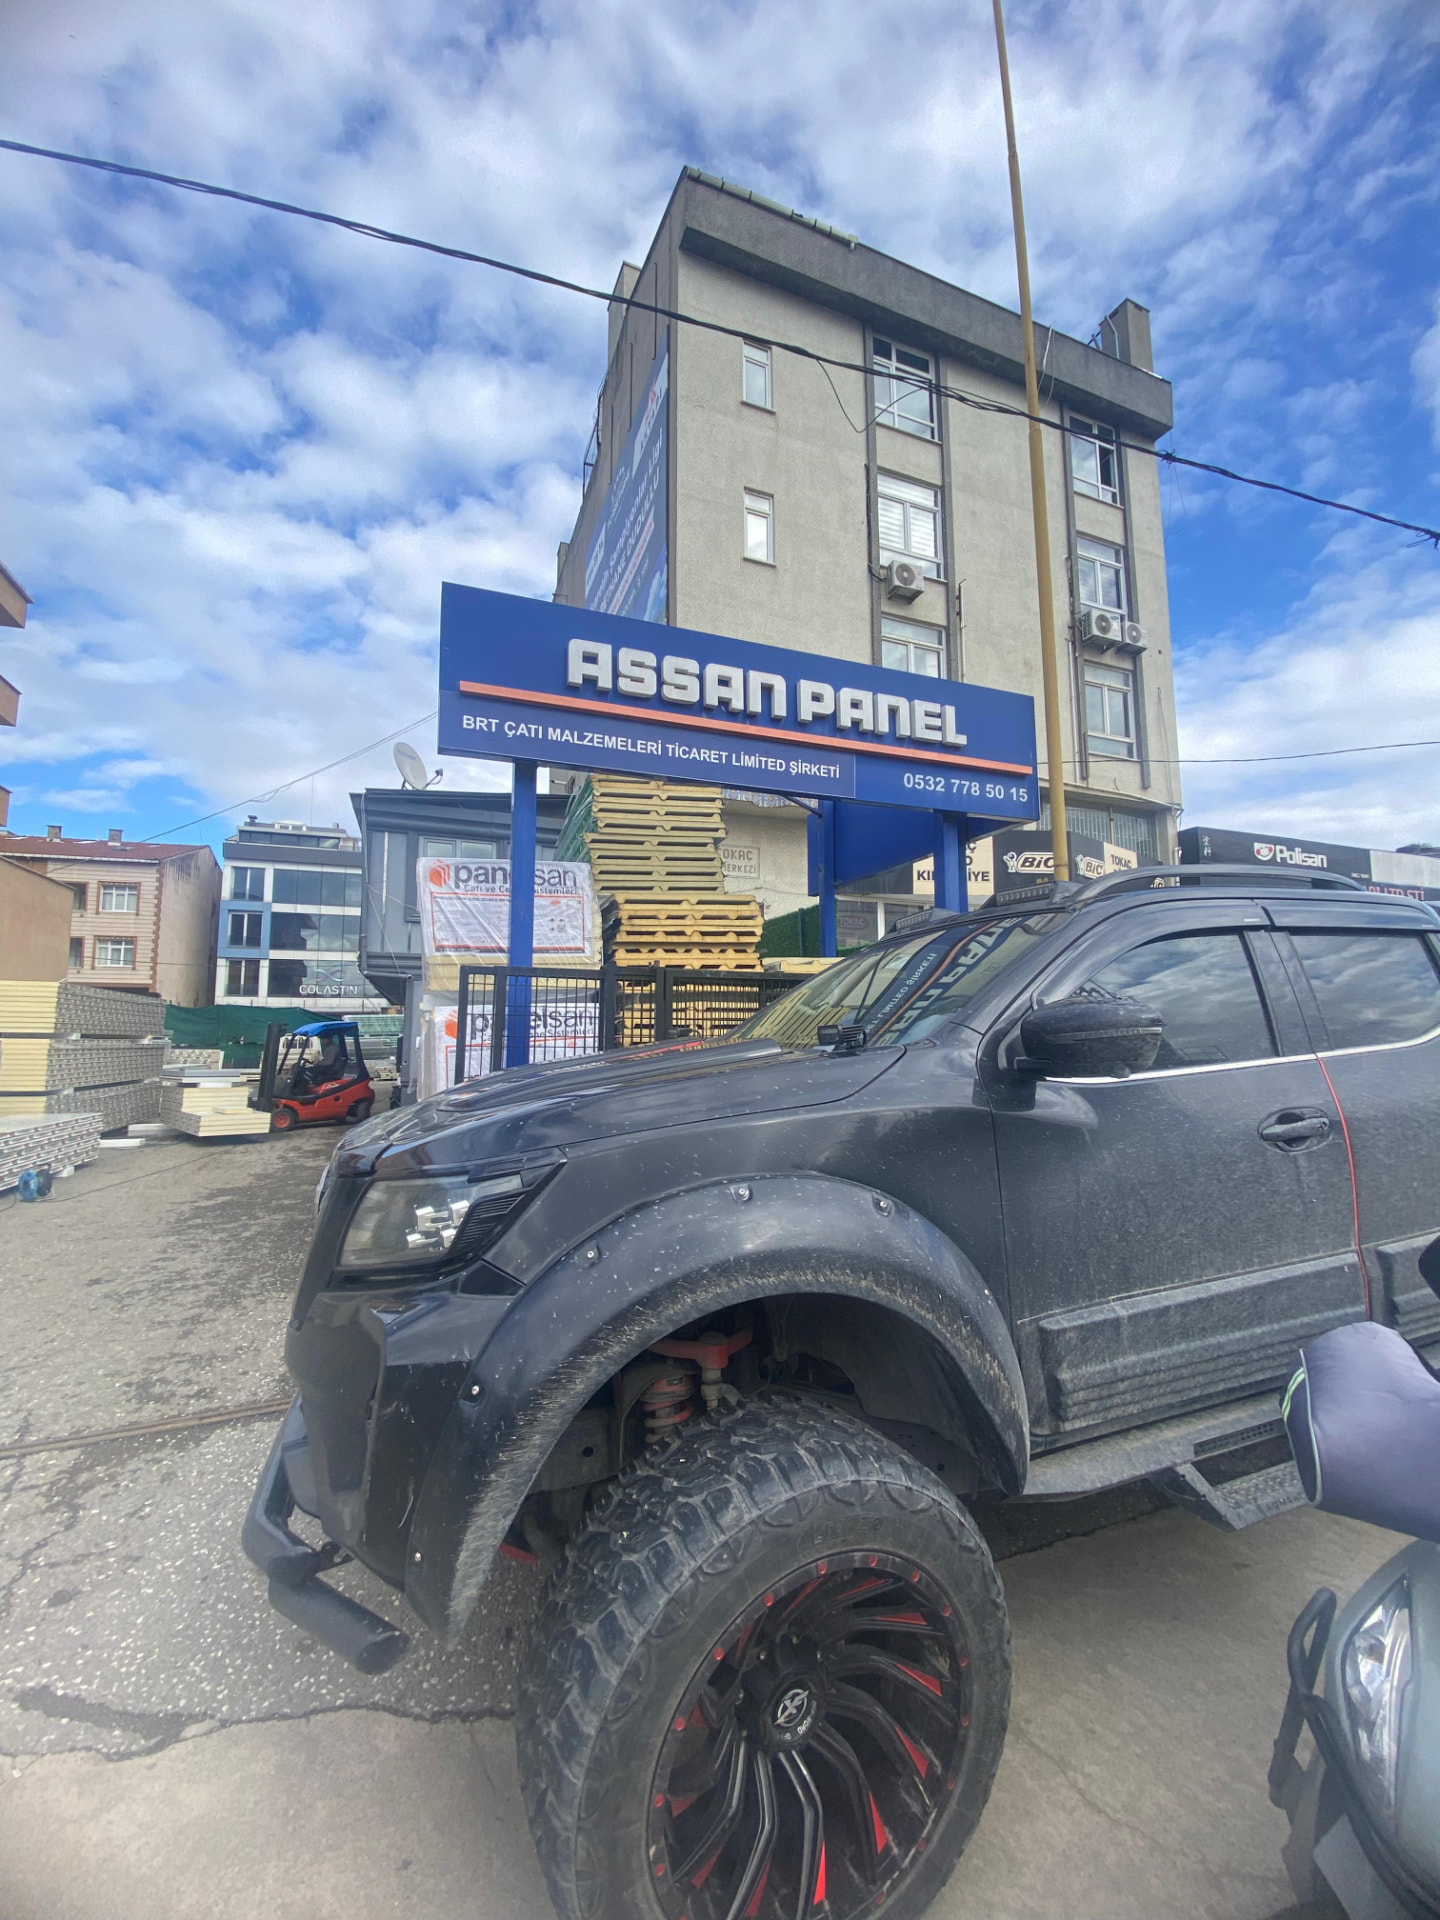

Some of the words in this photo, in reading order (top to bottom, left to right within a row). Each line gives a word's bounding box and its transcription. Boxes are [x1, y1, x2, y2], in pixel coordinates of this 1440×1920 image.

[567, 638, 787, 719] ASSAN
[796, 678, 968, 748] PANEL
[462, 714, 499, 732] BRT
[504, 721, 543, 738] ÇATI
[547, 727, 662, 756] MALZEMELERİ
[665, 742, 729, 764] TİCARET
[732, 751, 786, 772] LİMİTED
[789, 759, 840, 779] ŞİRKETİ
[903, 772, 945, 792] 0532
[950, 779, 980, 796] 778
[985, 784, 1005, 799] 50
[1009, 787, 1028, 802] 15
[1275, 845, 1328, 868] Polisan
[299, 984, 358, 995] COLASTIN
